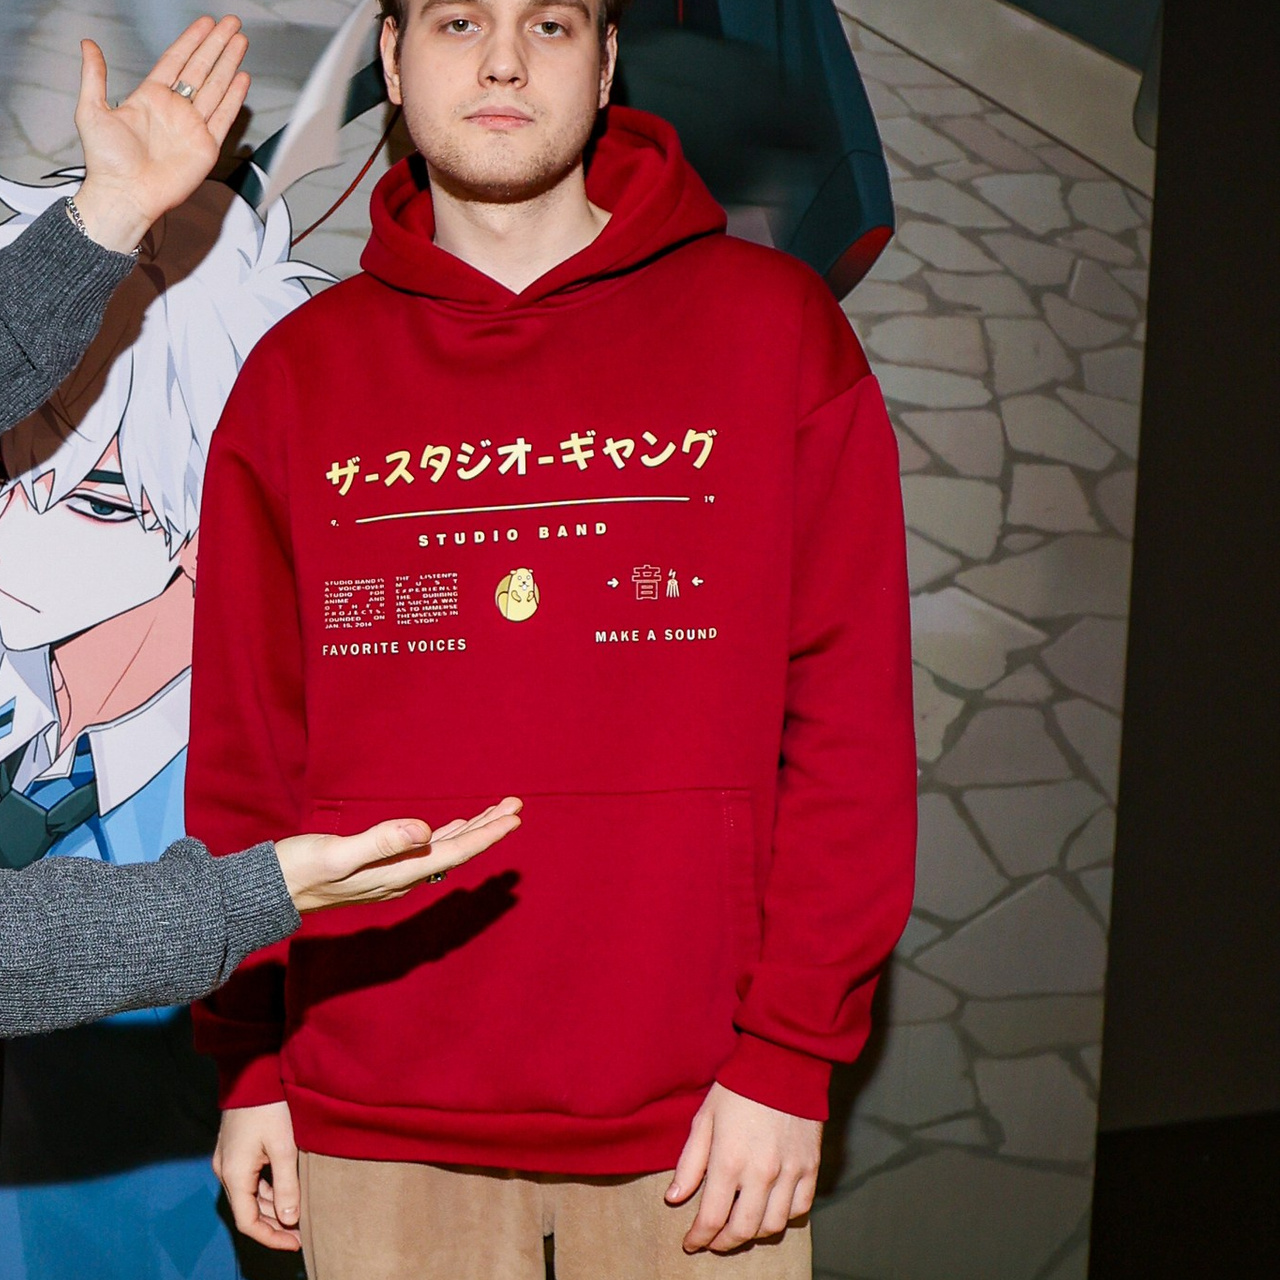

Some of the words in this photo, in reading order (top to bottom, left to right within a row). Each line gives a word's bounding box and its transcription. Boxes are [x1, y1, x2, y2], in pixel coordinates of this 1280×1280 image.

[418, 528, 519, 547] STUDIO
[538, 522, 607, 539] BAND
[595, 630, 640, 643] MAKE
[647, 630, 656, 640] A
[664, 627, 718, 641] SOUND
[322, 641, 400, 656] FAVORITE
[407, 638, 467, 652] VOICES
